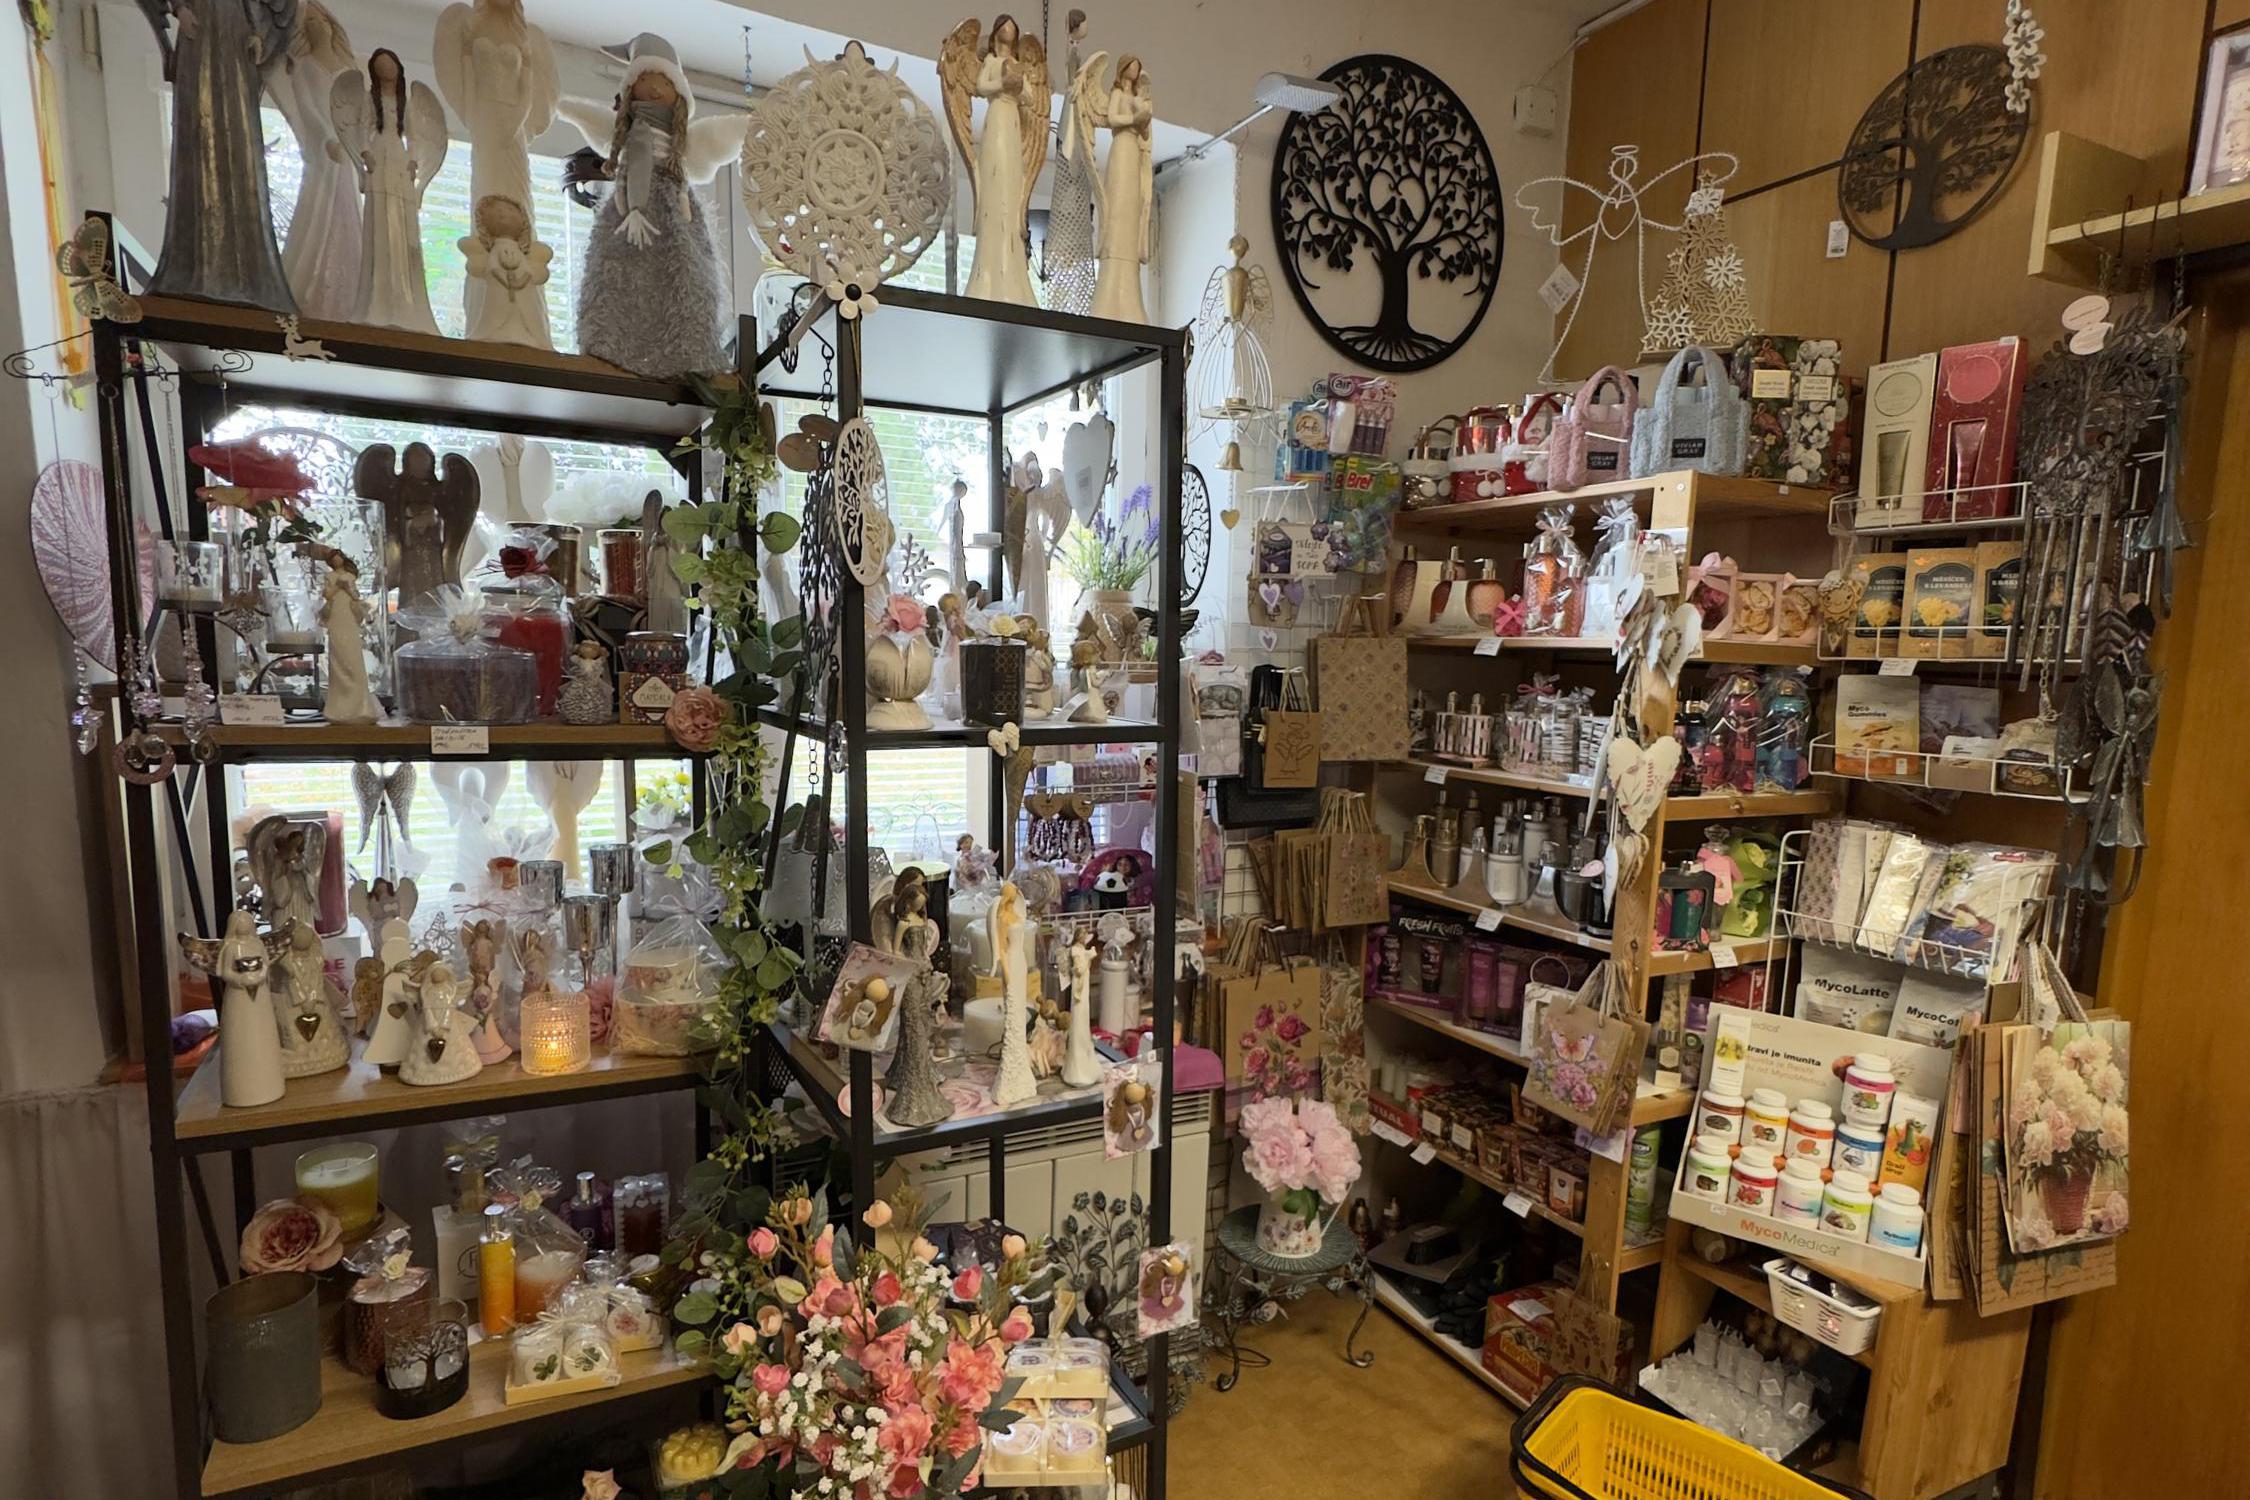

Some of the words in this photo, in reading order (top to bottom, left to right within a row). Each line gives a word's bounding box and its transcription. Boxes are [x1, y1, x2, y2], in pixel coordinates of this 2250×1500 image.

[1398, 917, 1432, 932] FRESH
[1814, 978, 1890, 999] MycoLatte
[1906, 1005, 1960, 1027] MycoCof
[1783, 1052, 1822, 1067] imunita
[1740, 1219, 1840, 1257] MycoMedica
